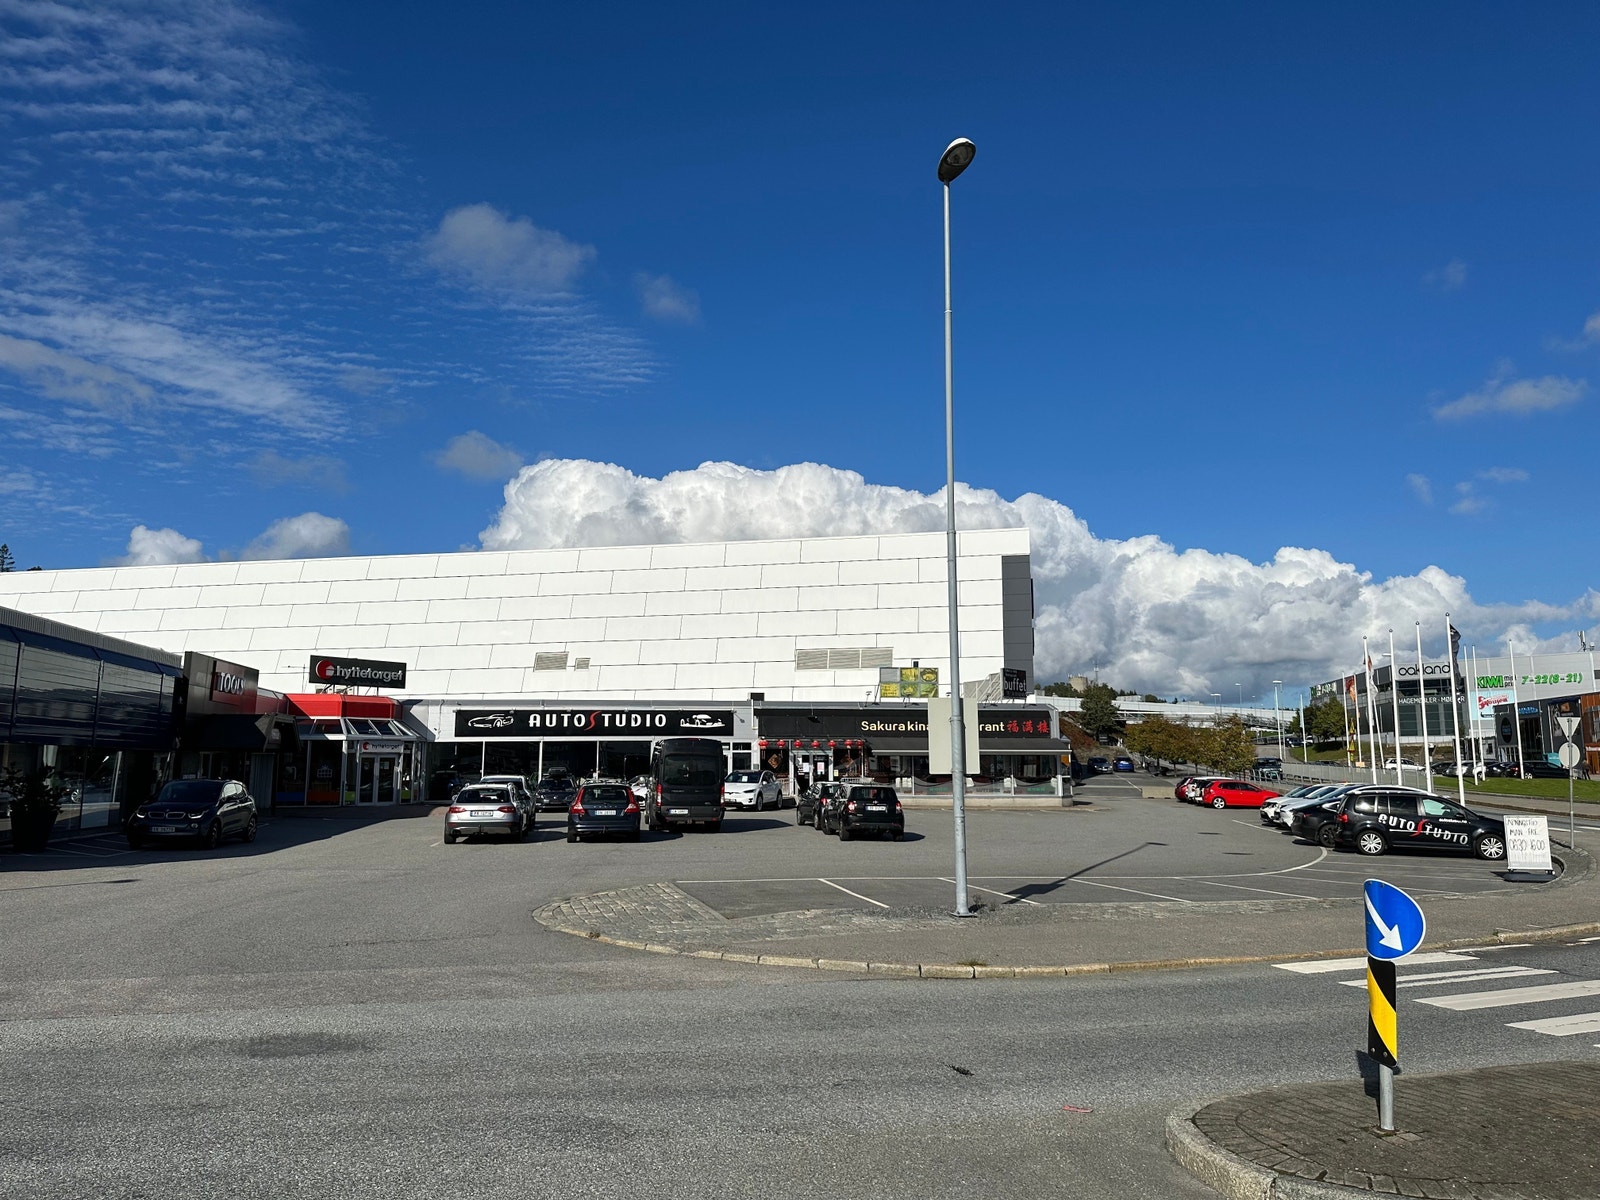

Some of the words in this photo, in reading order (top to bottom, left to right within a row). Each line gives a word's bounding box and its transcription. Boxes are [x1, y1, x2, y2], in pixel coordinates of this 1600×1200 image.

[336, 665, 404, 682] hyttetorget
[1398, 661, 1451, 676] oakland
[1003, 676, 1027, 692] buffet
[1476, 675, 1504, 689] KIWI
[528, 710, 668, 732] AUTOSTUDIO
[860, 720, 906, 731] Sakura
[1378, 813, 1469, 845] AUTOSTUDIO
